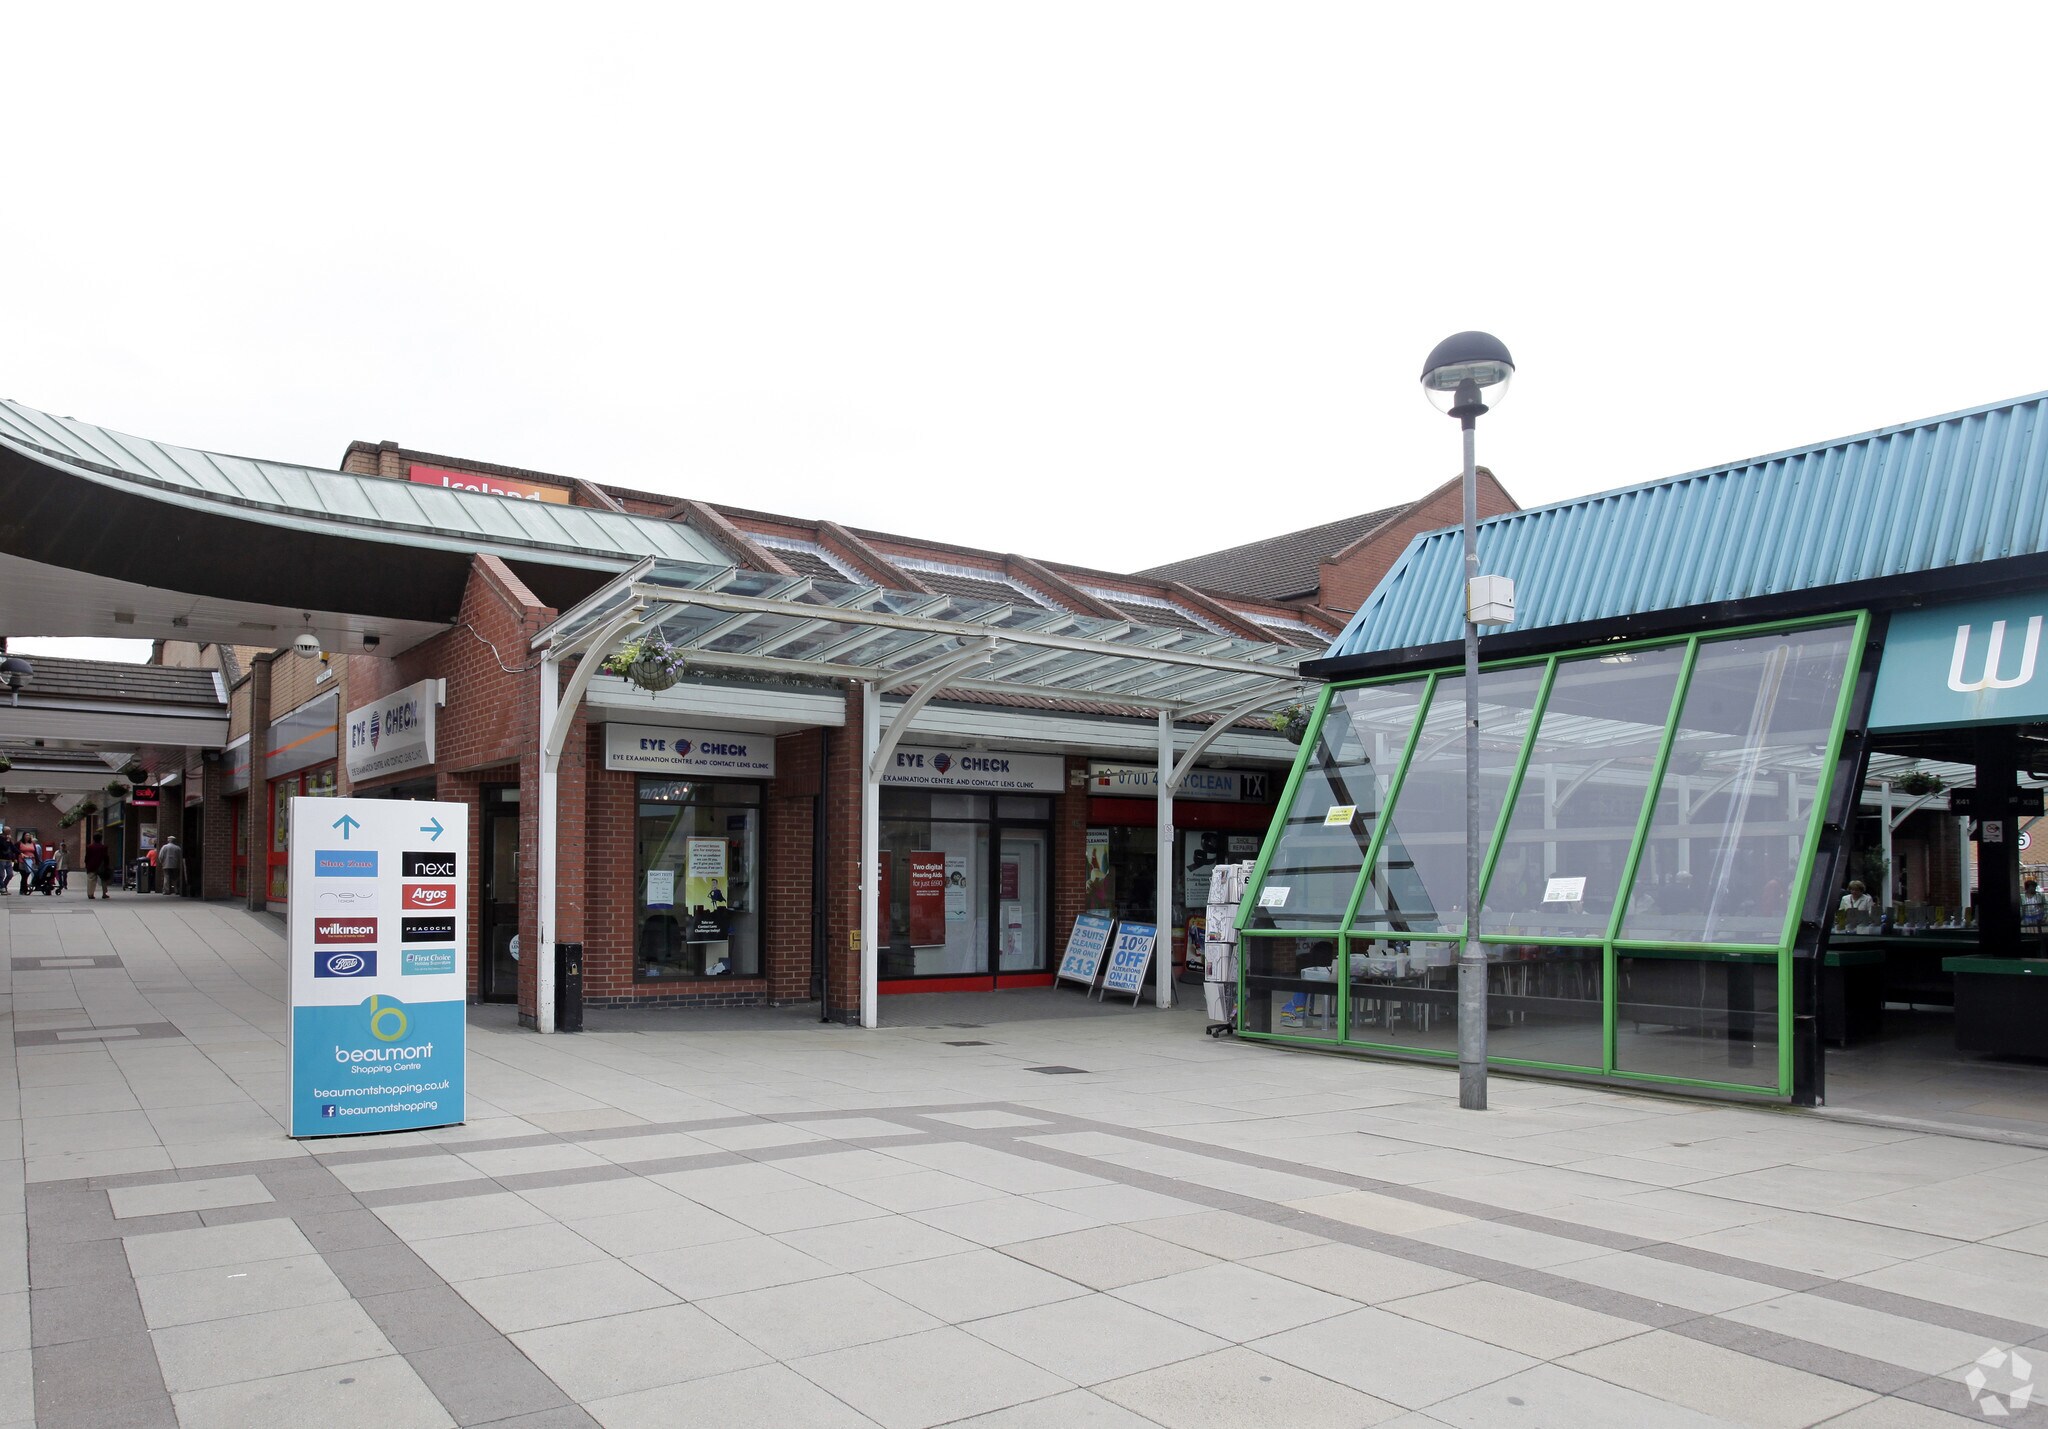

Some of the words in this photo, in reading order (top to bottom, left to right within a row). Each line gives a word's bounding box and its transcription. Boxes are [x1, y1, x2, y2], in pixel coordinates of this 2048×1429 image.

[352, 720, 365, 748] EYE
[385, 700, 418, 736] CHECK
[640, 738, 666, 751] EYE
[700, 742, 747, 757] CHECK
[626, 754, 669, 763] EXAMINATION
[709, 760, 735, 768] CONTACT
[896, 753, 924, 768] EYE
[961, 757, 1010, 772] CHECK
[883, 775, 929, 784] EXAMINATION
[956, 778, 970, 786] AND
[971, 779, 998, 787] CONTACT
[1119, 769, 1148, 786] 0700
[1244, 775, 1262, 796] TX
[136, 788, 156, 798] sally
[320, 859, 344, 867] Shoe
[415, 862, 454, 875] next
[925, 864, 943, 872] digital
[920, 880, 930, 888] just
[412, 888, 447, 902] Argos
[319, 923, 374, 935] wilkinson
[1074, 928, 1080, 937] 2
[1082, 929, 1104, 941] SUITS
[1072, 938, 1101, 950] CLEANED
[1119, 936, 1148, 952] 10%
[414, 954, 430, 962] First
[430, 953, 451, 961] Choice
[1082, 949, 1098, 958] ONLY
[1115, 951, 1145, 967] OFF
[332, 958, 358, 970] Boots
[1062, 956, 1095, 976] £13
[1112, 966, 1140, 974] ALTERATIONS
[1109, 972, 1123, 980] ON
[1123, 974, 1138, 983] ALL
[335, 1042, 433, 1063] beaumont
[351, 1065, 392, 1074] Shopping
[394, 1063, 421, 1072] Centre
[314, 1080, 450, 1098] beaumontshopping.co.uk
[339, 1101, 437, 1116] beaumontshopping
